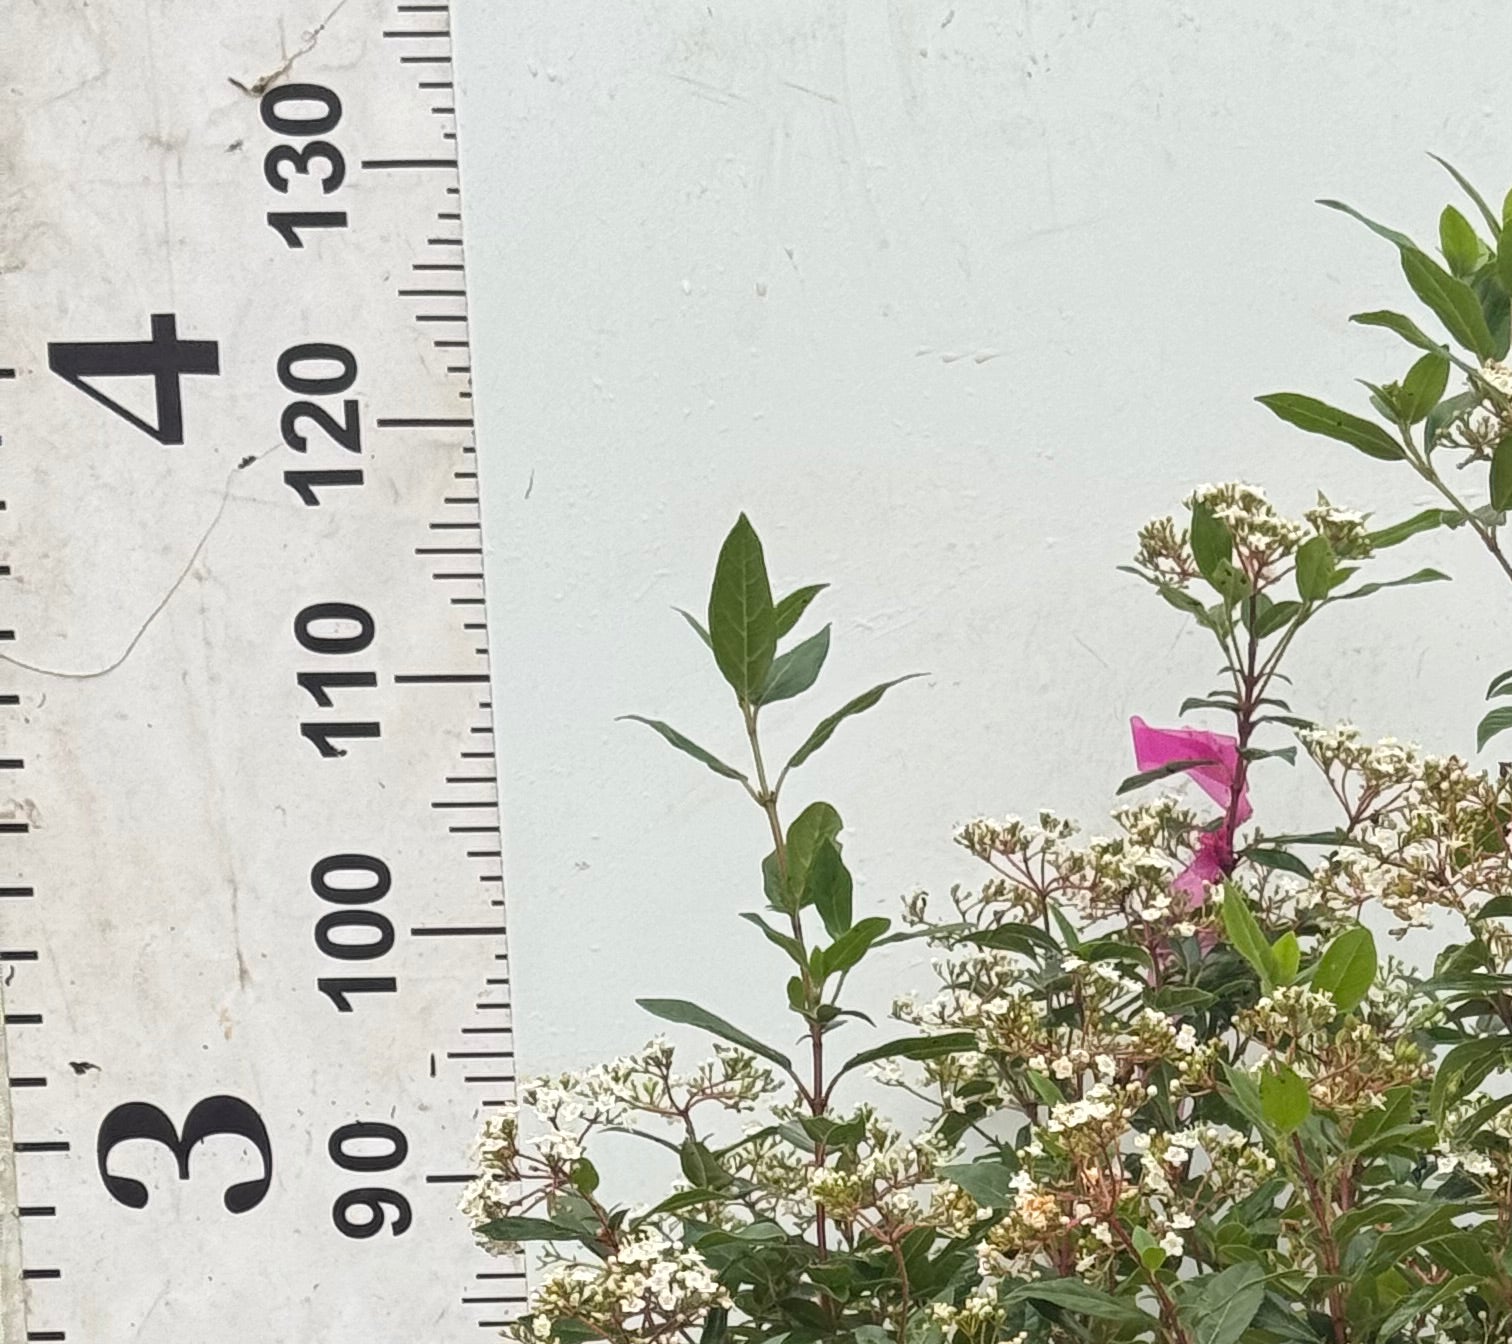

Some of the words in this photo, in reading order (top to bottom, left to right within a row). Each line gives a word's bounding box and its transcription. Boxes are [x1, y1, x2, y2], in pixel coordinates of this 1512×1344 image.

[260, 83, 347, 248] 130
[47, 313, 220, 446] 4
[277, 343, 364, 507] 120
[294, 602, 382, 759] 110
[311, 853, 397, 1012] 100
[97, 1095, 273, 1214] 3
[328, 1120, 412, 1239] 90
